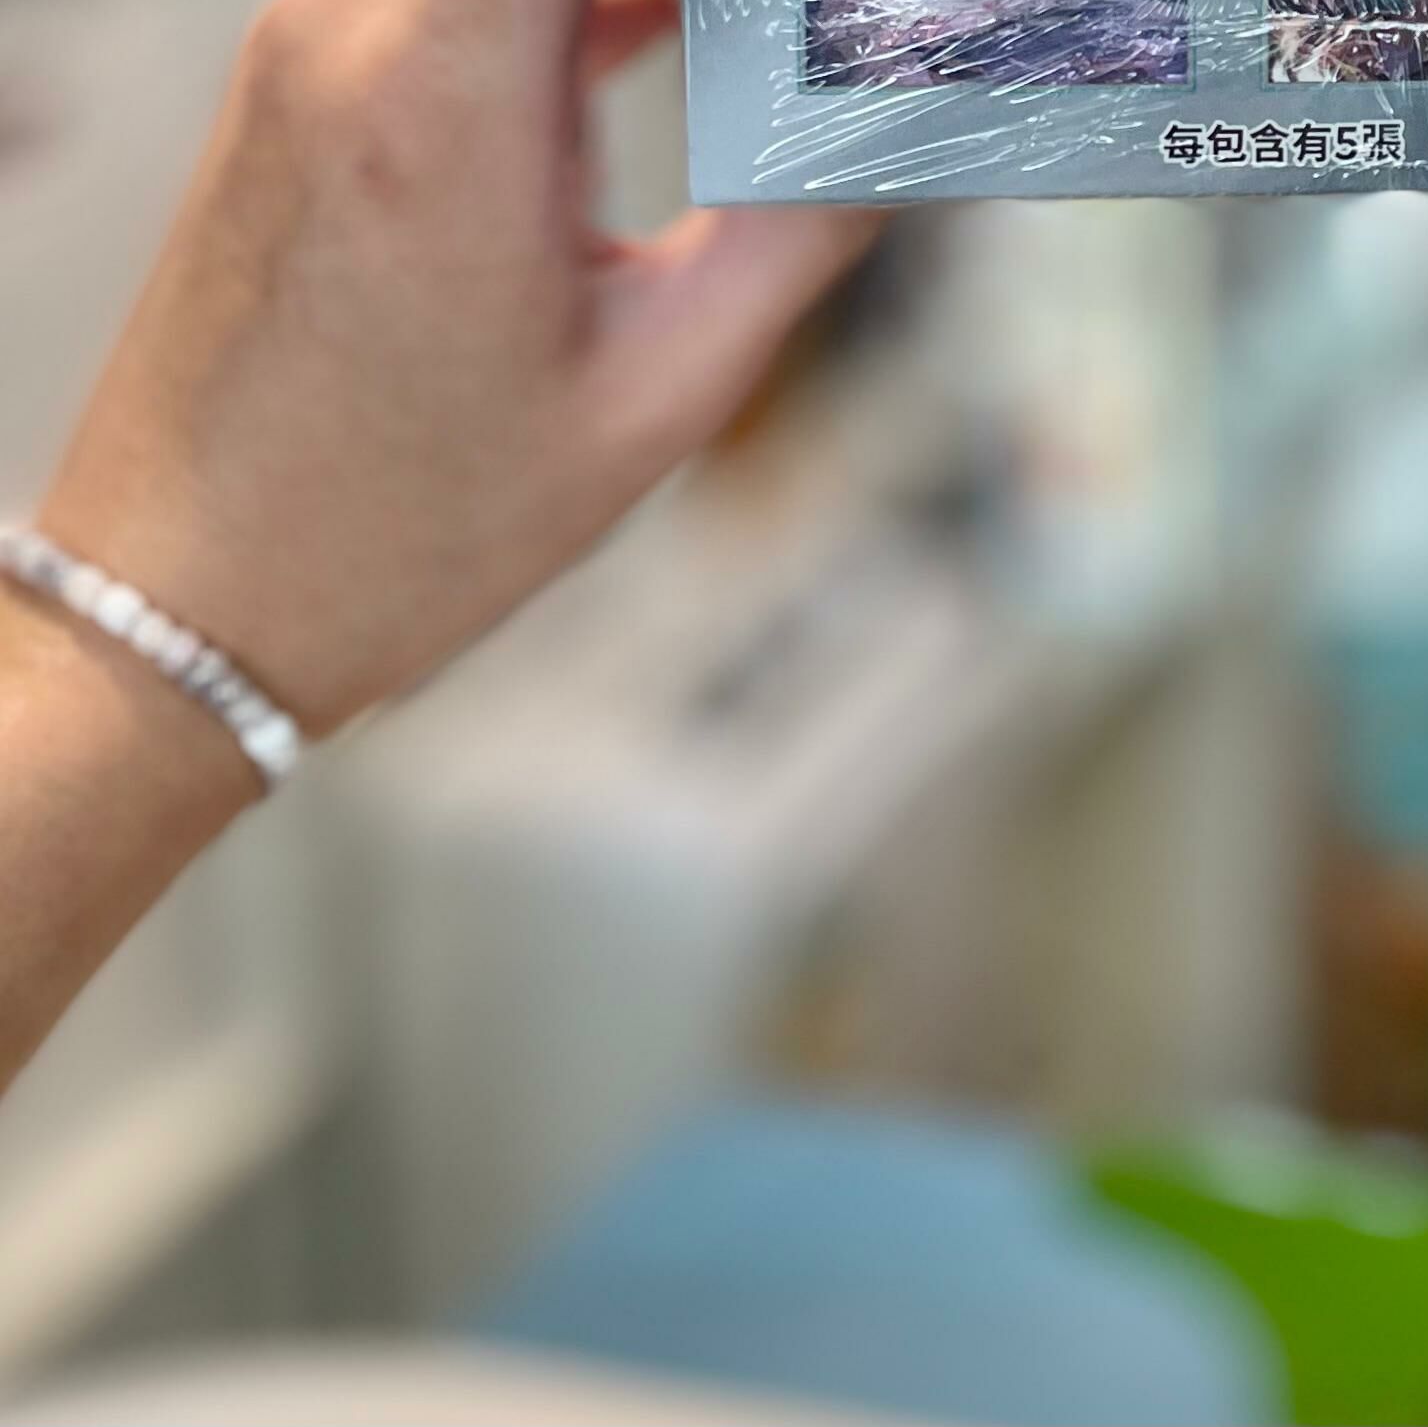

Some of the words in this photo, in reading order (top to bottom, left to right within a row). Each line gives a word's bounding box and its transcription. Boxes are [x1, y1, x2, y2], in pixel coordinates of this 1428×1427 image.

[1162, 121, 1404, 164] 每包含有5張
